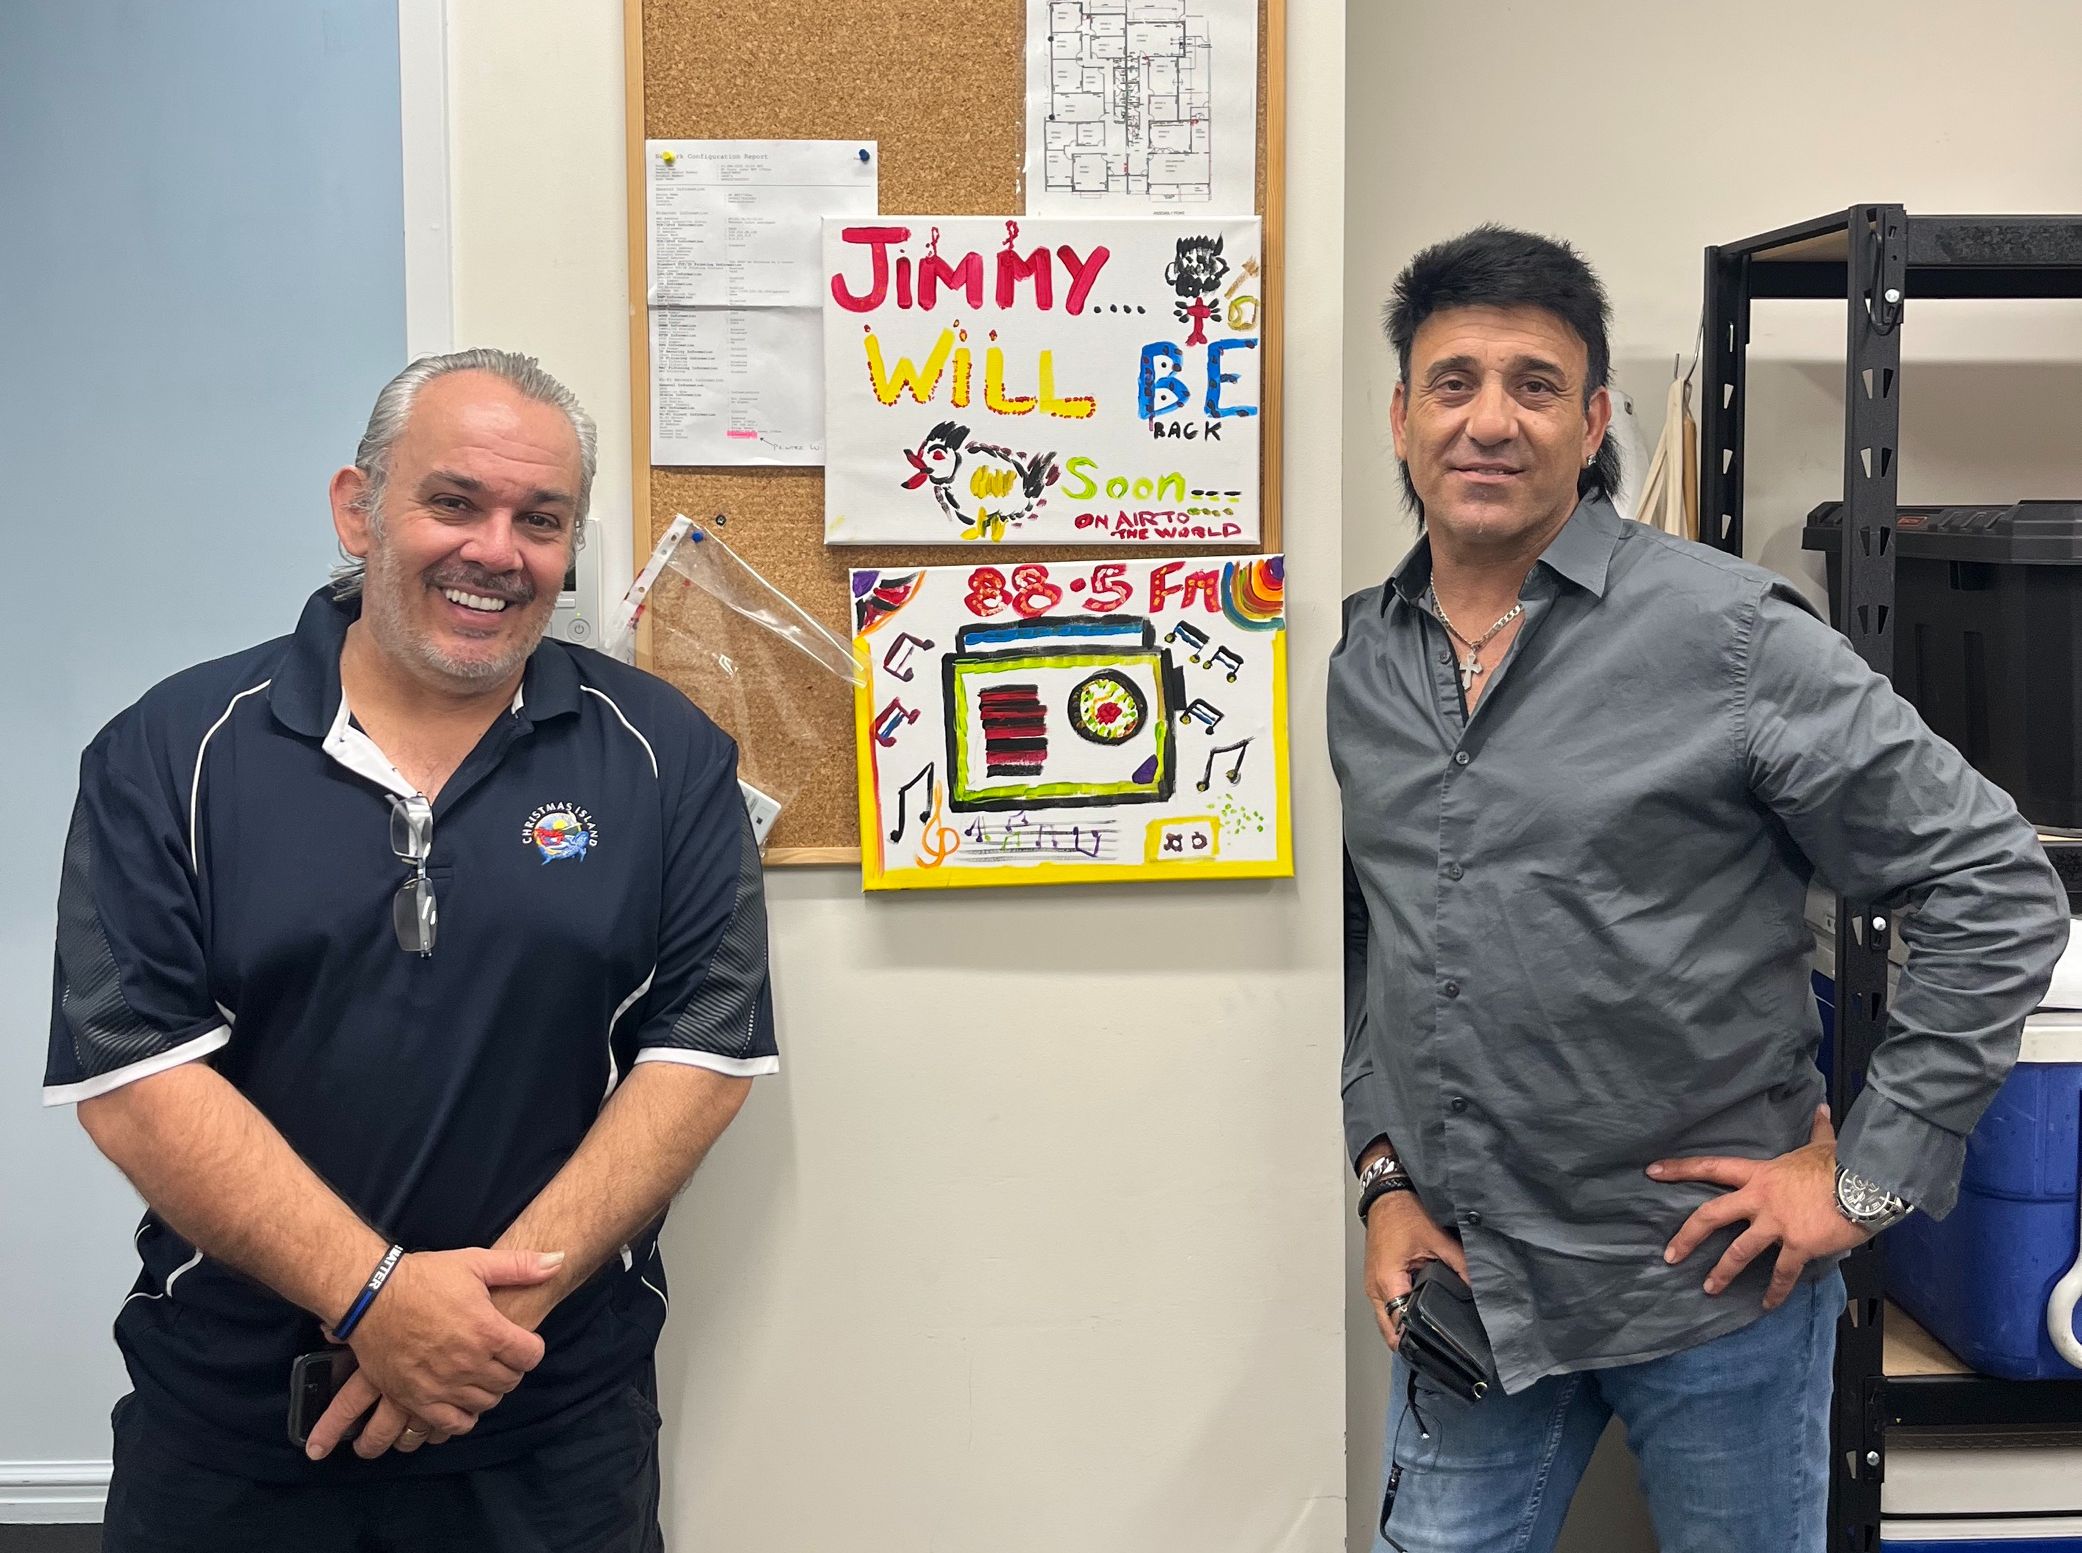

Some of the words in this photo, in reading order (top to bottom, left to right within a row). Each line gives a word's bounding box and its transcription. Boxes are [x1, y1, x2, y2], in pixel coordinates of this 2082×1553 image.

[687, 152, 741, 161] Configuration
[744, 152, 769, 161] Report
[1137, 338, 1259, 420] BE
[1154, 420, 1222, 442] BACK
[1074, 512, 1109, 530] ON
[1110, 528, 1150, 540] THE
[1154, 522, 1242, 540] WORLD
[521, 801, 573, 844] CHRISTMAS
[575, 806, 599, 847] ISLAND
[368, 1247, 402, 1290] MATTER
